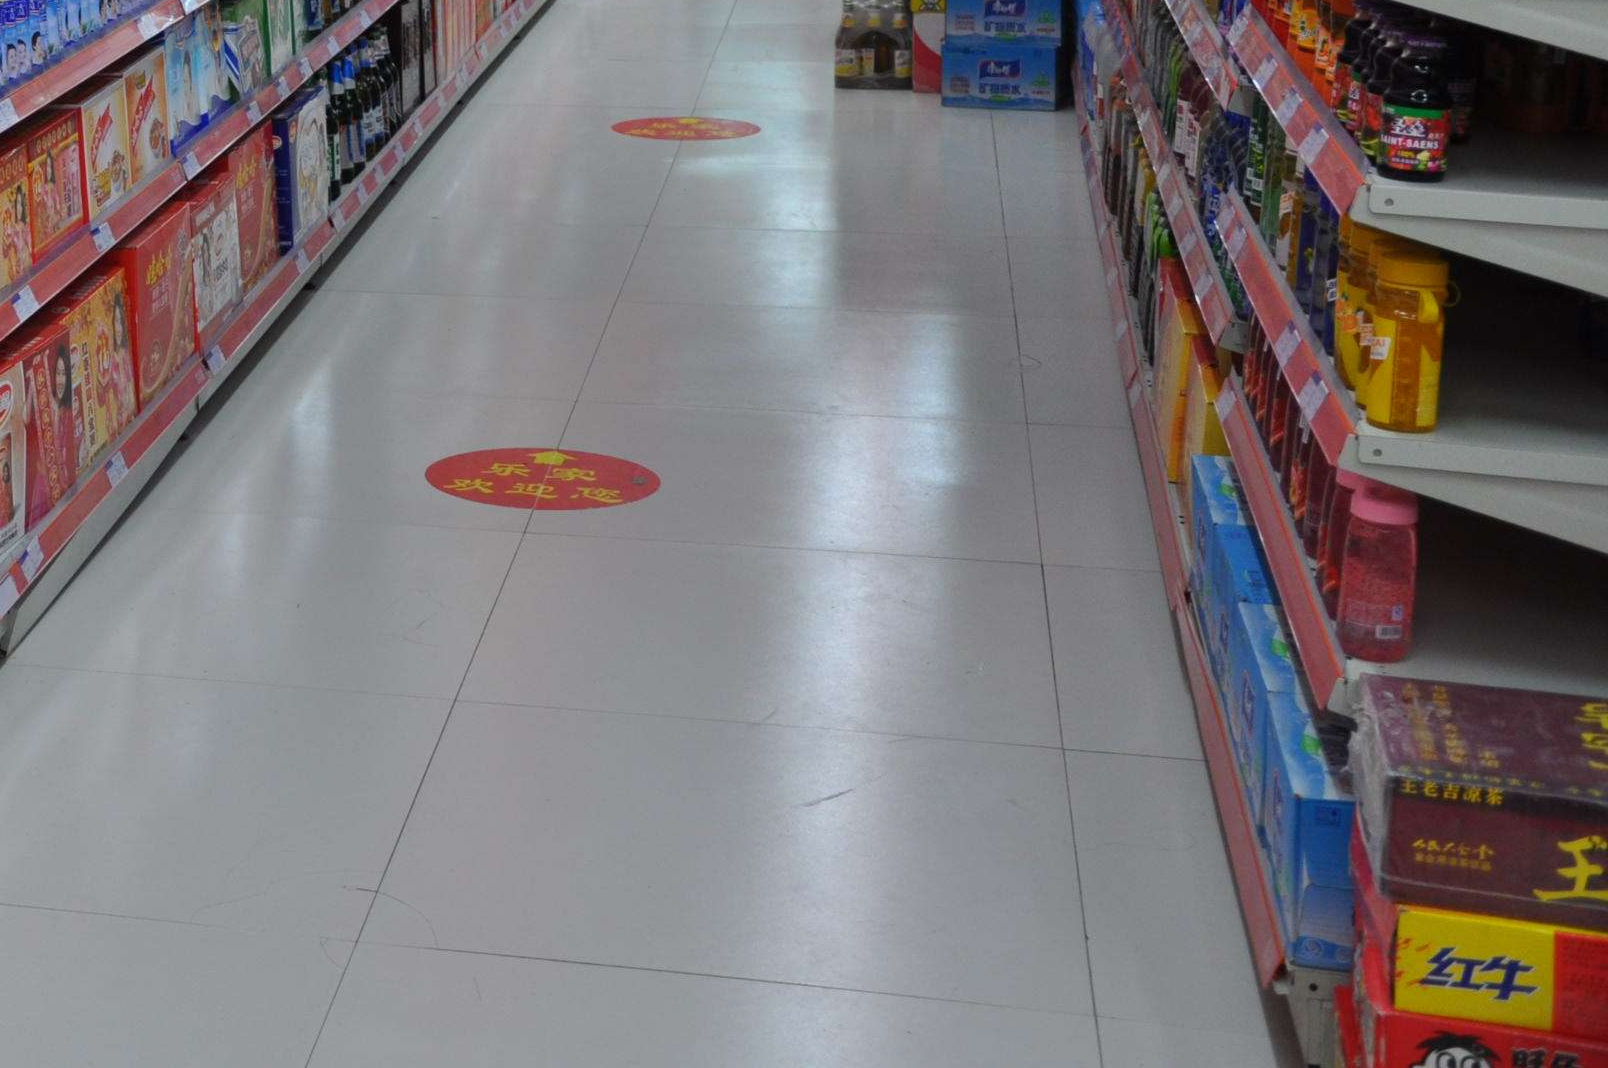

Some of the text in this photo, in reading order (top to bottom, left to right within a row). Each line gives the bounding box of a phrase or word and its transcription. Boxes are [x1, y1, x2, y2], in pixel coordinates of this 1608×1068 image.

[443, 478, 624, 504] 欢迎您
[1418, 946, 1542, 1002] 红牛
